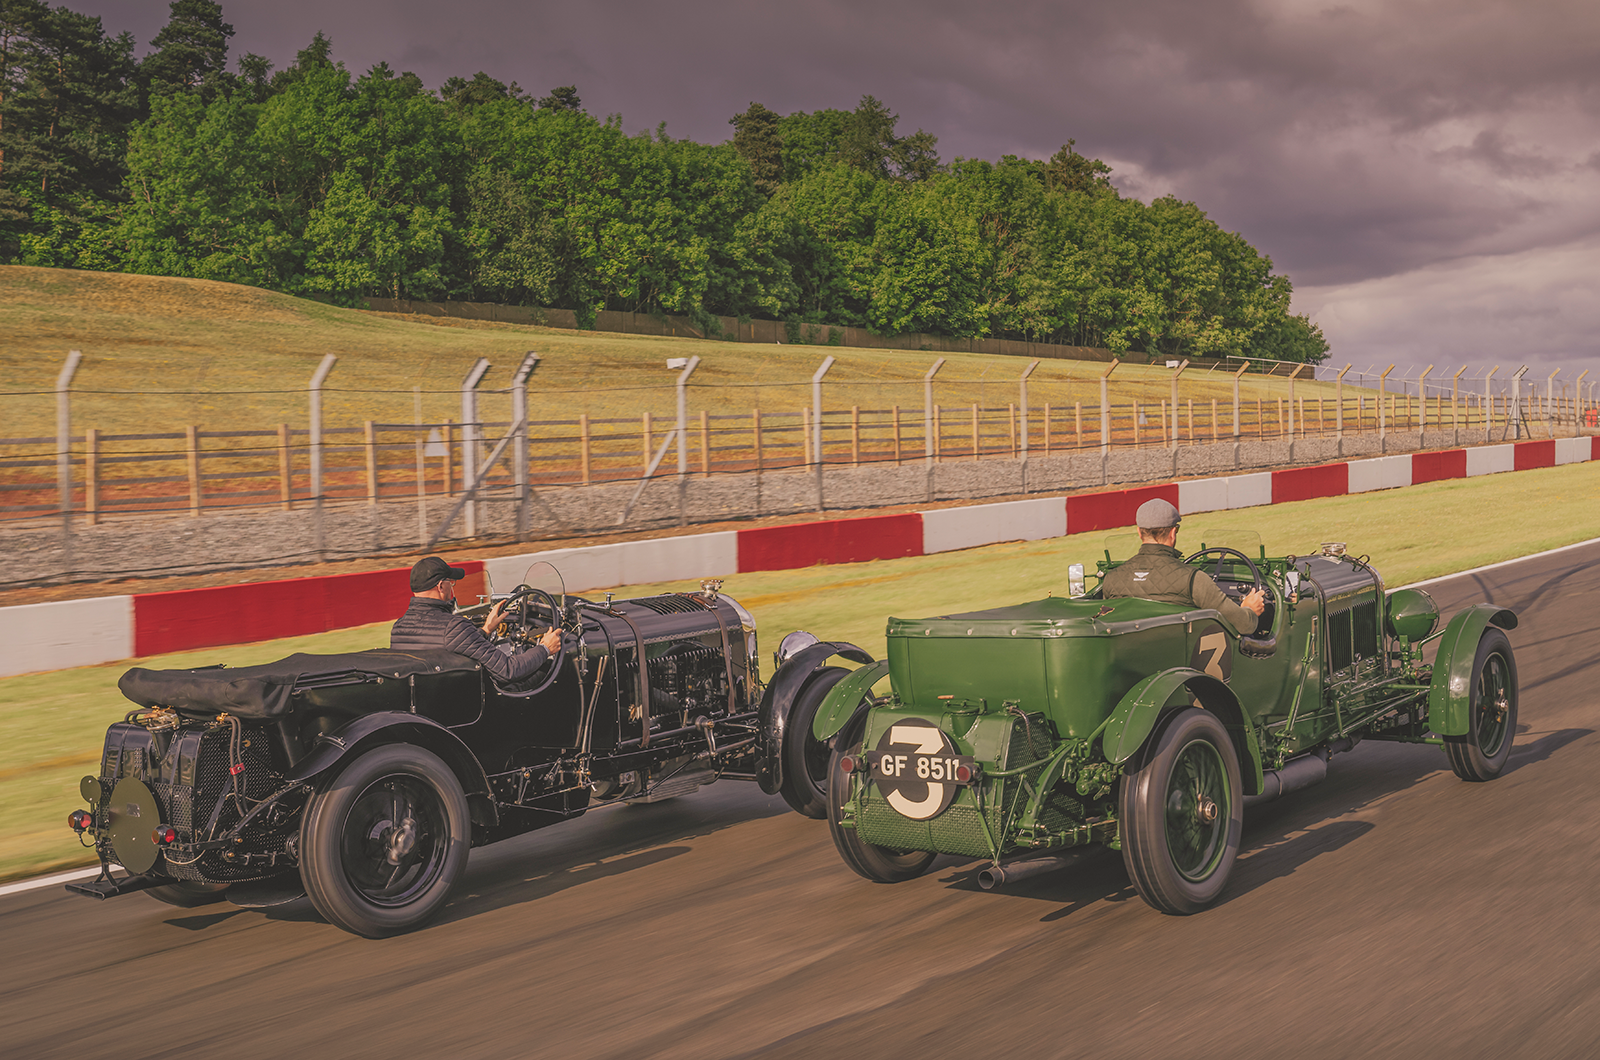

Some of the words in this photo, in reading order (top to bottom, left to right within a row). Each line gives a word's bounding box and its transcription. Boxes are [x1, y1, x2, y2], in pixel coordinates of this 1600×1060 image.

[880, 754, 908, 777] GF
[916, 756, 960, 781] 8511
[886, 725, 945, 819] 3
